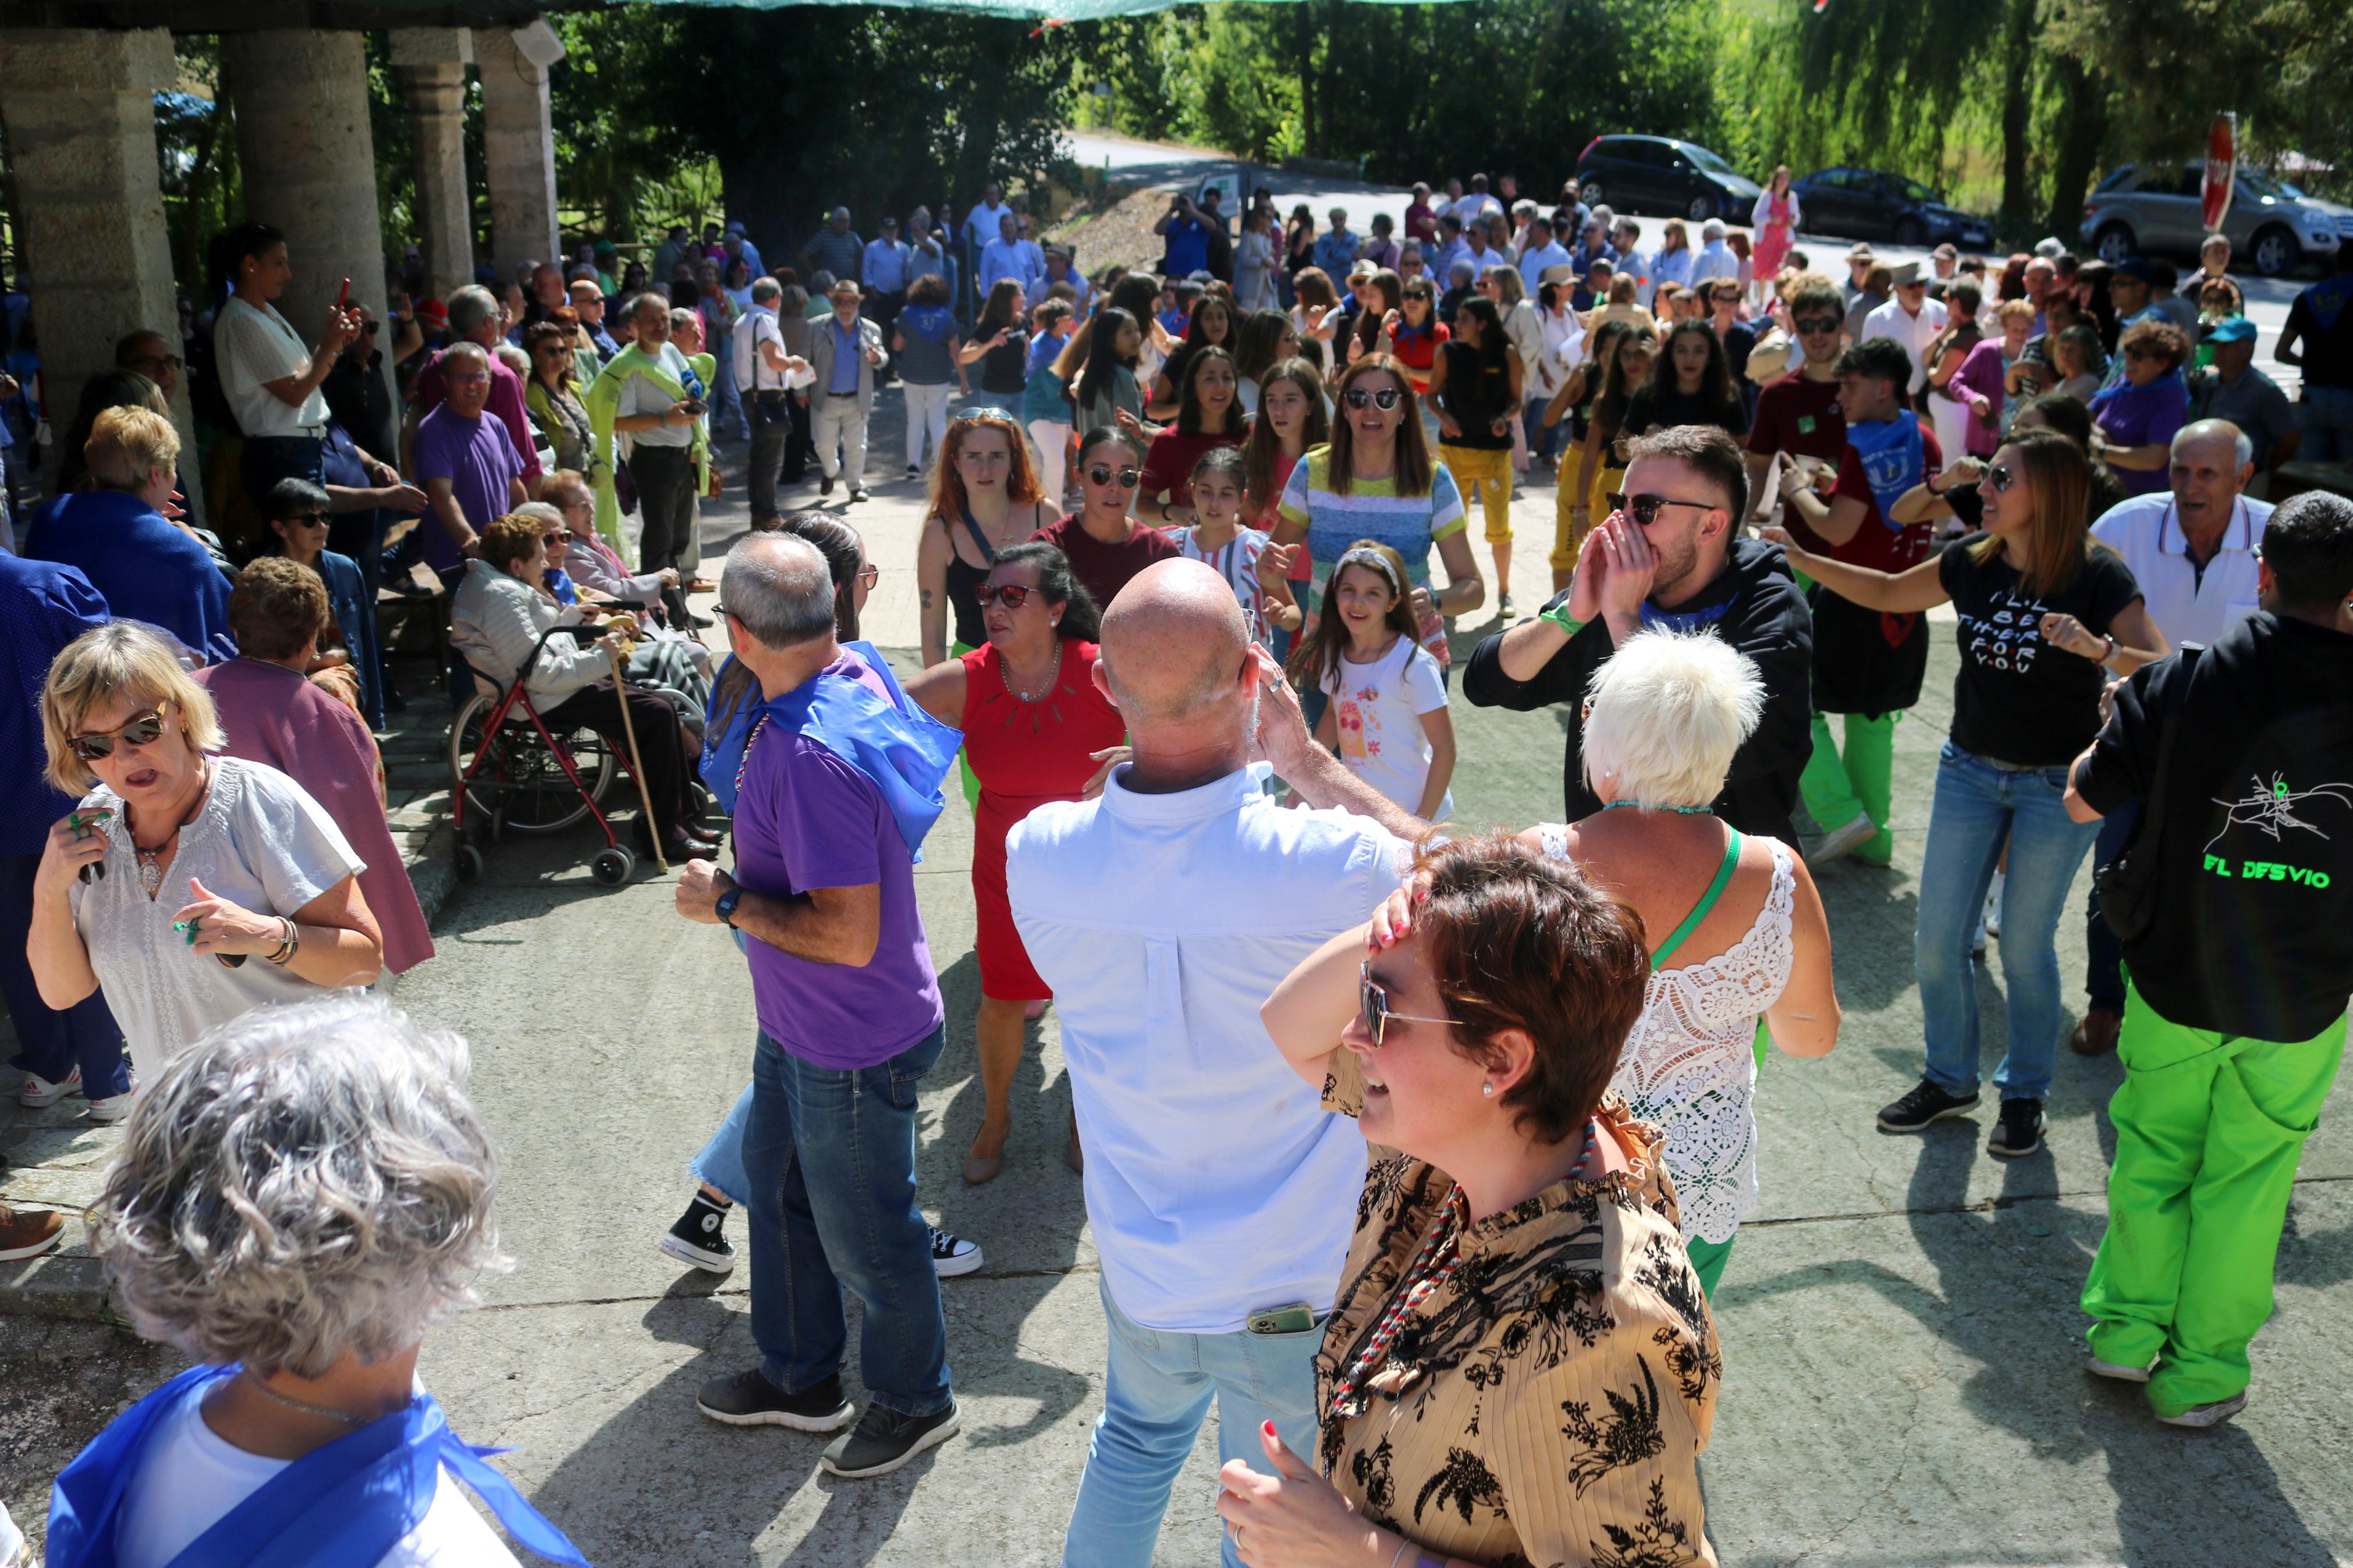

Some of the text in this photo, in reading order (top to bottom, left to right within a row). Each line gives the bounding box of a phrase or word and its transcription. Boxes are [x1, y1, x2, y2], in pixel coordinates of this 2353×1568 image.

[1958, 613, 2053, 646] THER
[2203, 853, 2330, 889] EL DESVIO
